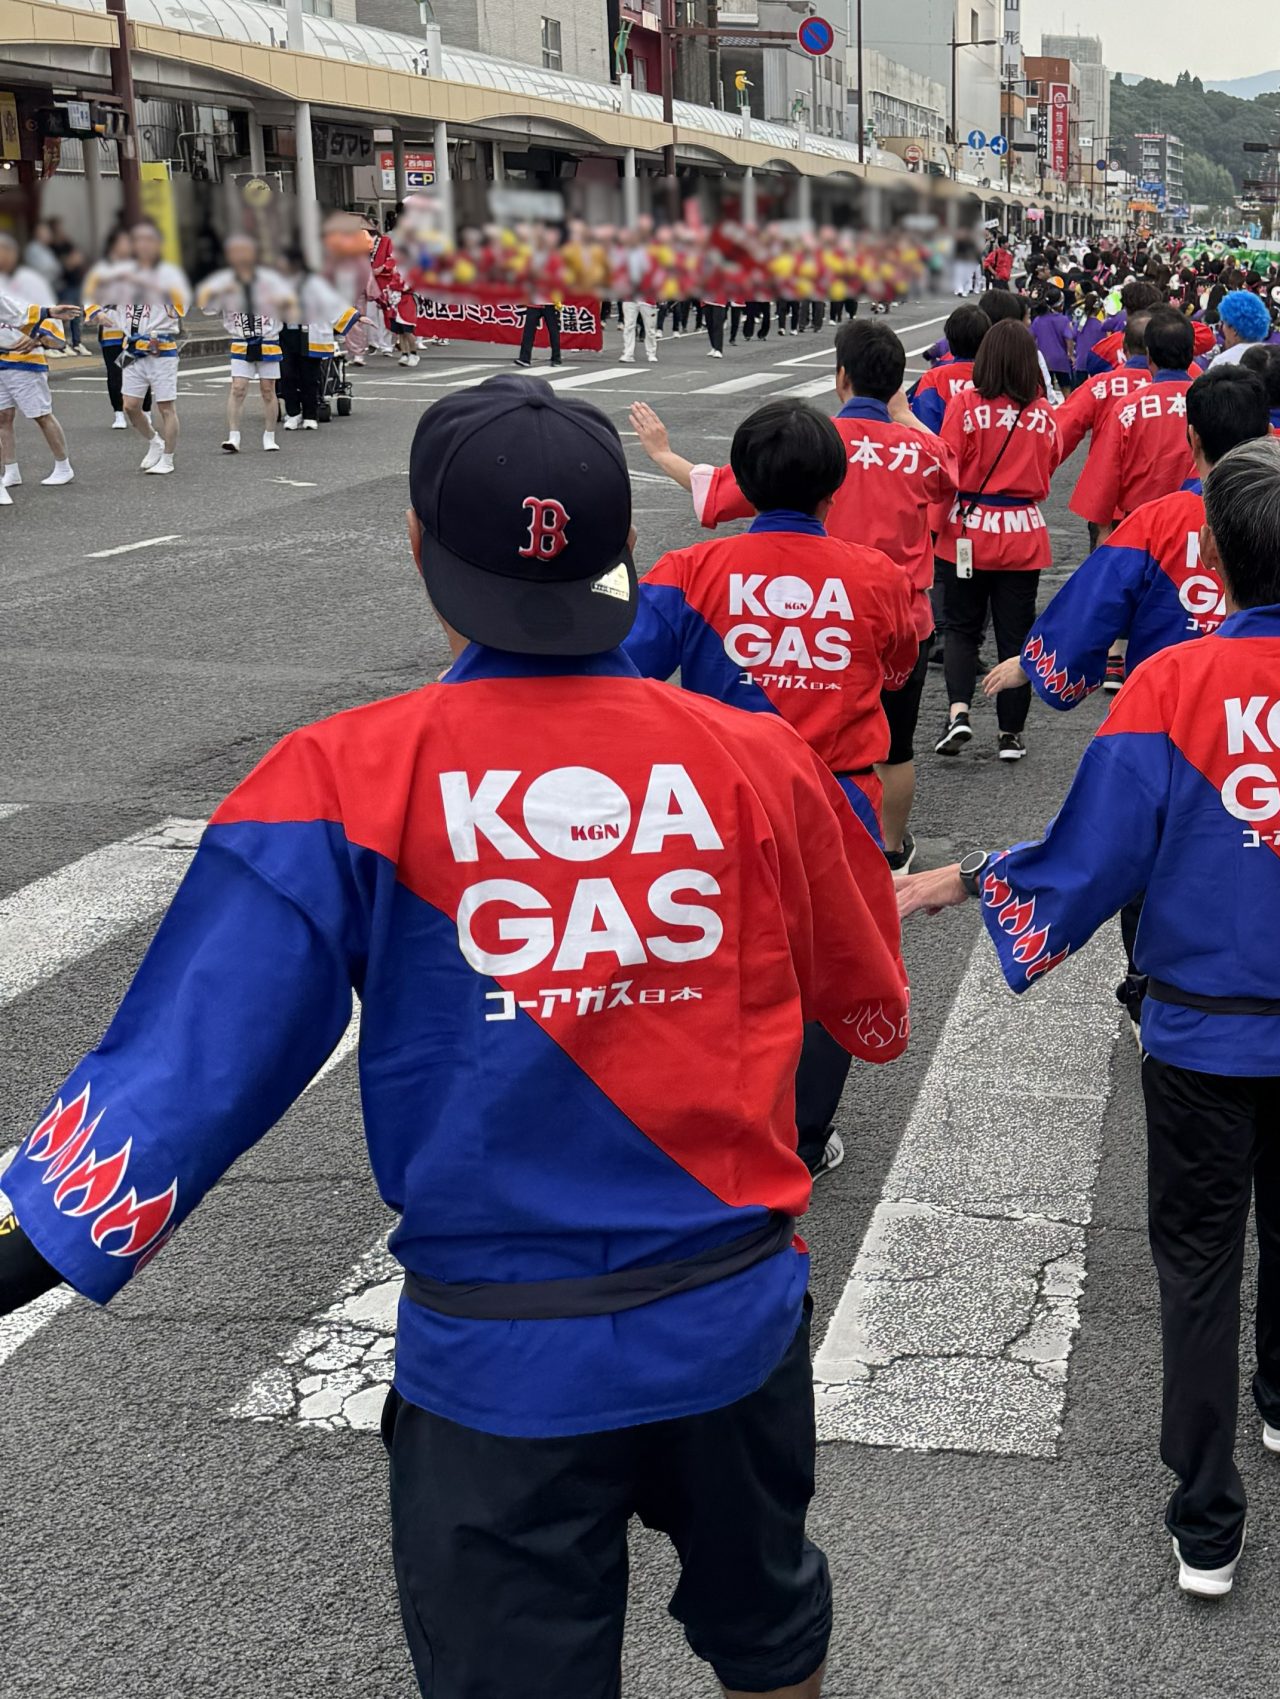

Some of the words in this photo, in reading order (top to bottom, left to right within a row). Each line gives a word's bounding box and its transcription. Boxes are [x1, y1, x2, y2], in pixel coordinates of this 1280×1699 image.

[423, 174, 434, 185] P
[518, 496, 571, 561] B
[729, 573, 855, 621] KOA
[784, 602, 808, 611] KGN
[723, 623, 852, 671] GAS
[739, 671, 842, 690] コーアガス日本
[438, 763, 725, 863] KOA
[570, 823, 620, 841] KGN
[456, 868, 724, 977] GAS
[484, 979, 703, 1022] コーアガス日本
